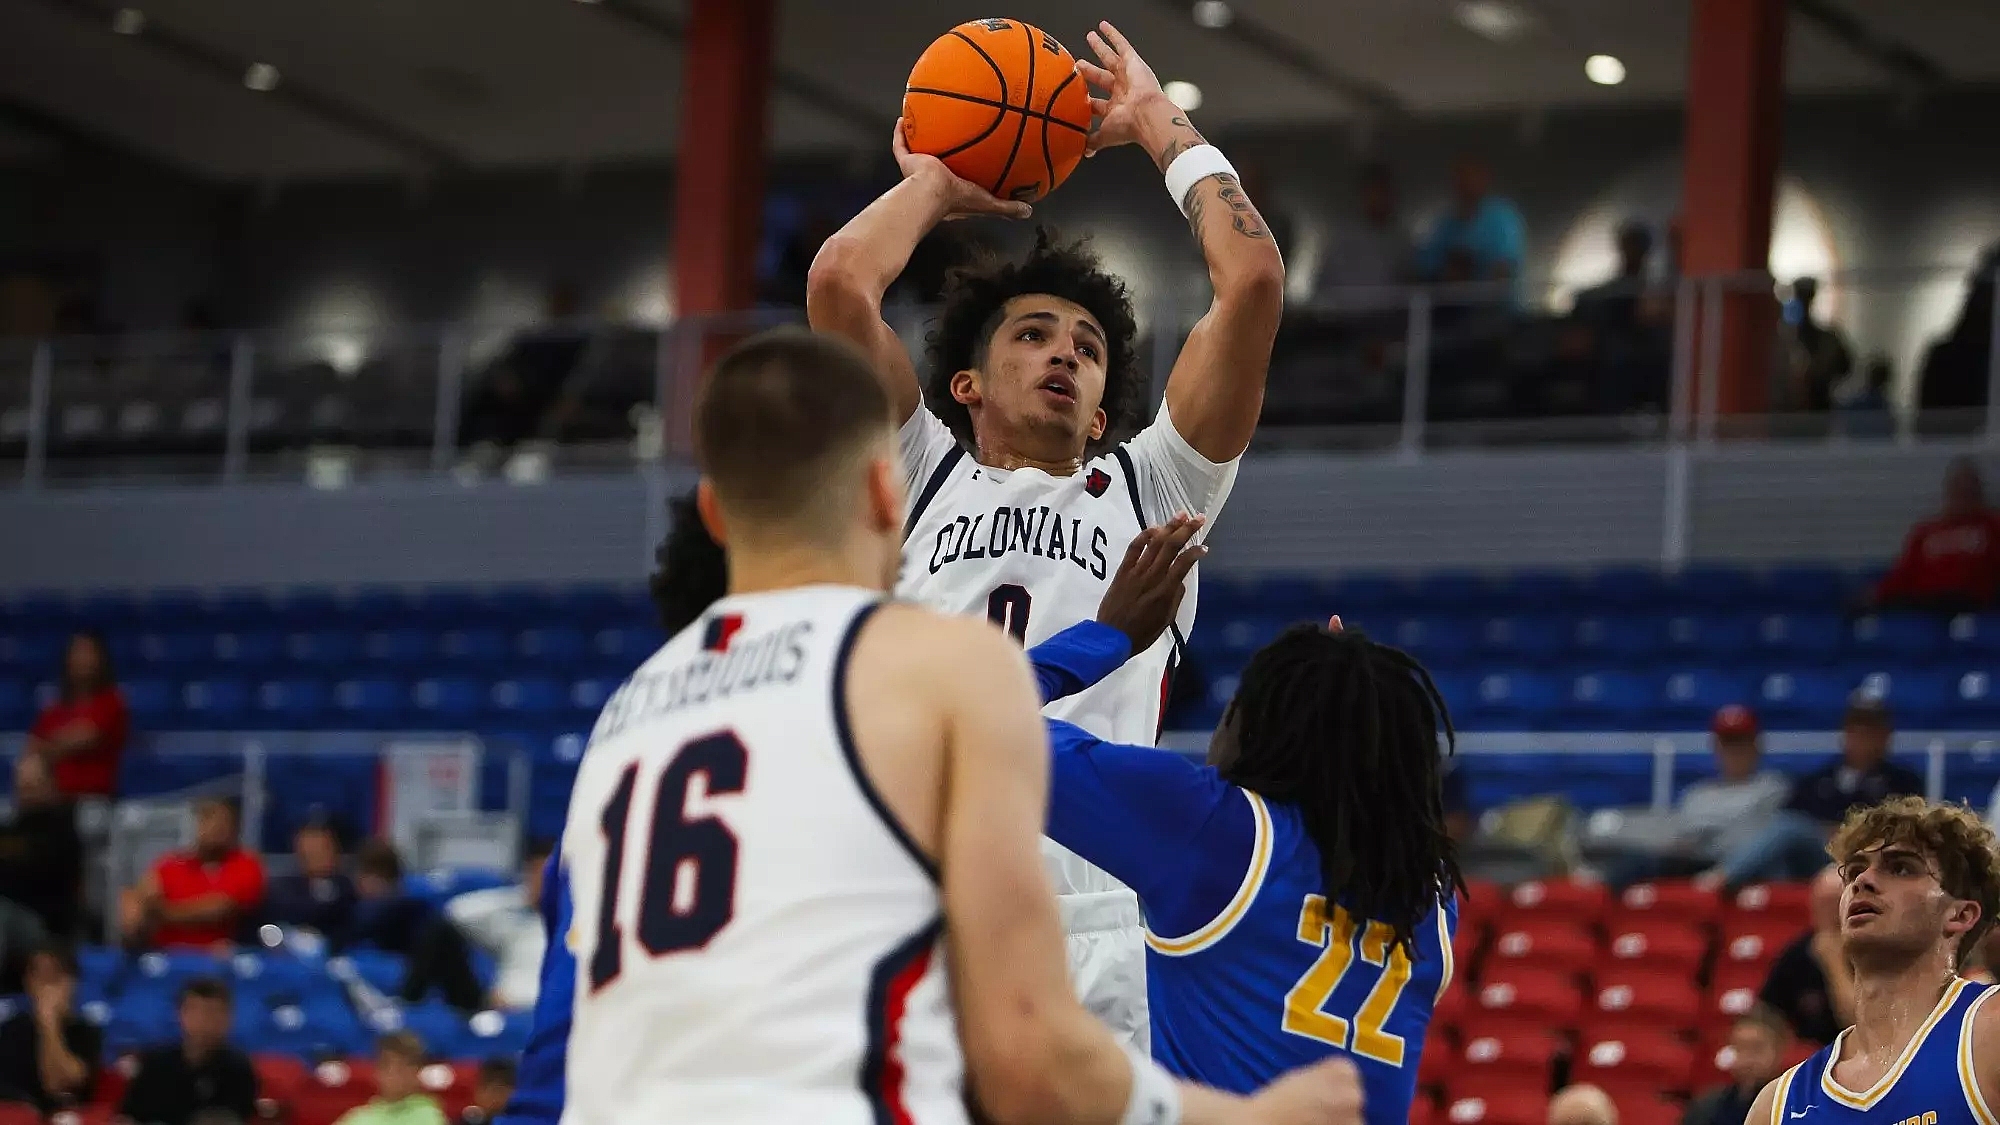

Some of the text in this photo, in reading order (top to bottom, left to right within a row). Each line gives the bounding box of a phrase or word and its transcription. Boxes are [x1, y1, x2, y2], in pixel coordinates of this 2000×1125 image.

[928, 505, 1108, 582] COLONIALS
[589, 727, 750, 996] 16
[1281, 893, 1412, 1068] 22
